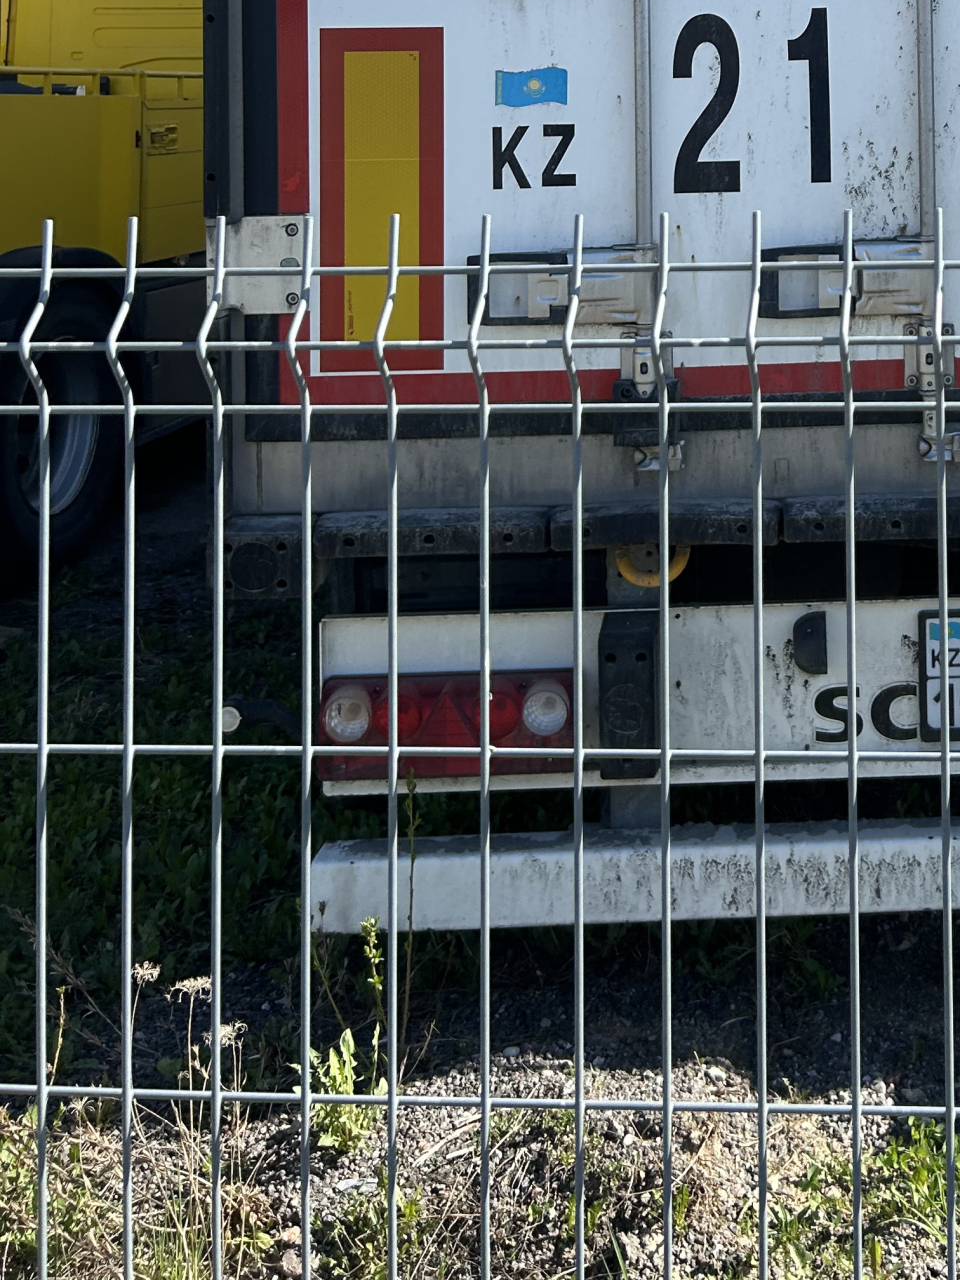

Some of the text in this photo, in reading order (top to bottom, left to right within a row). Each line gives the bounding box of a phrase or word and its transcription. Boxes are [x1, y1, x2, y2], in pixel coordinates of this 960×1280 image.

[673, 7, 832, 194] 21
[491, 123, 577, 190] KZ
[931, 647, 960, 669] KZ
